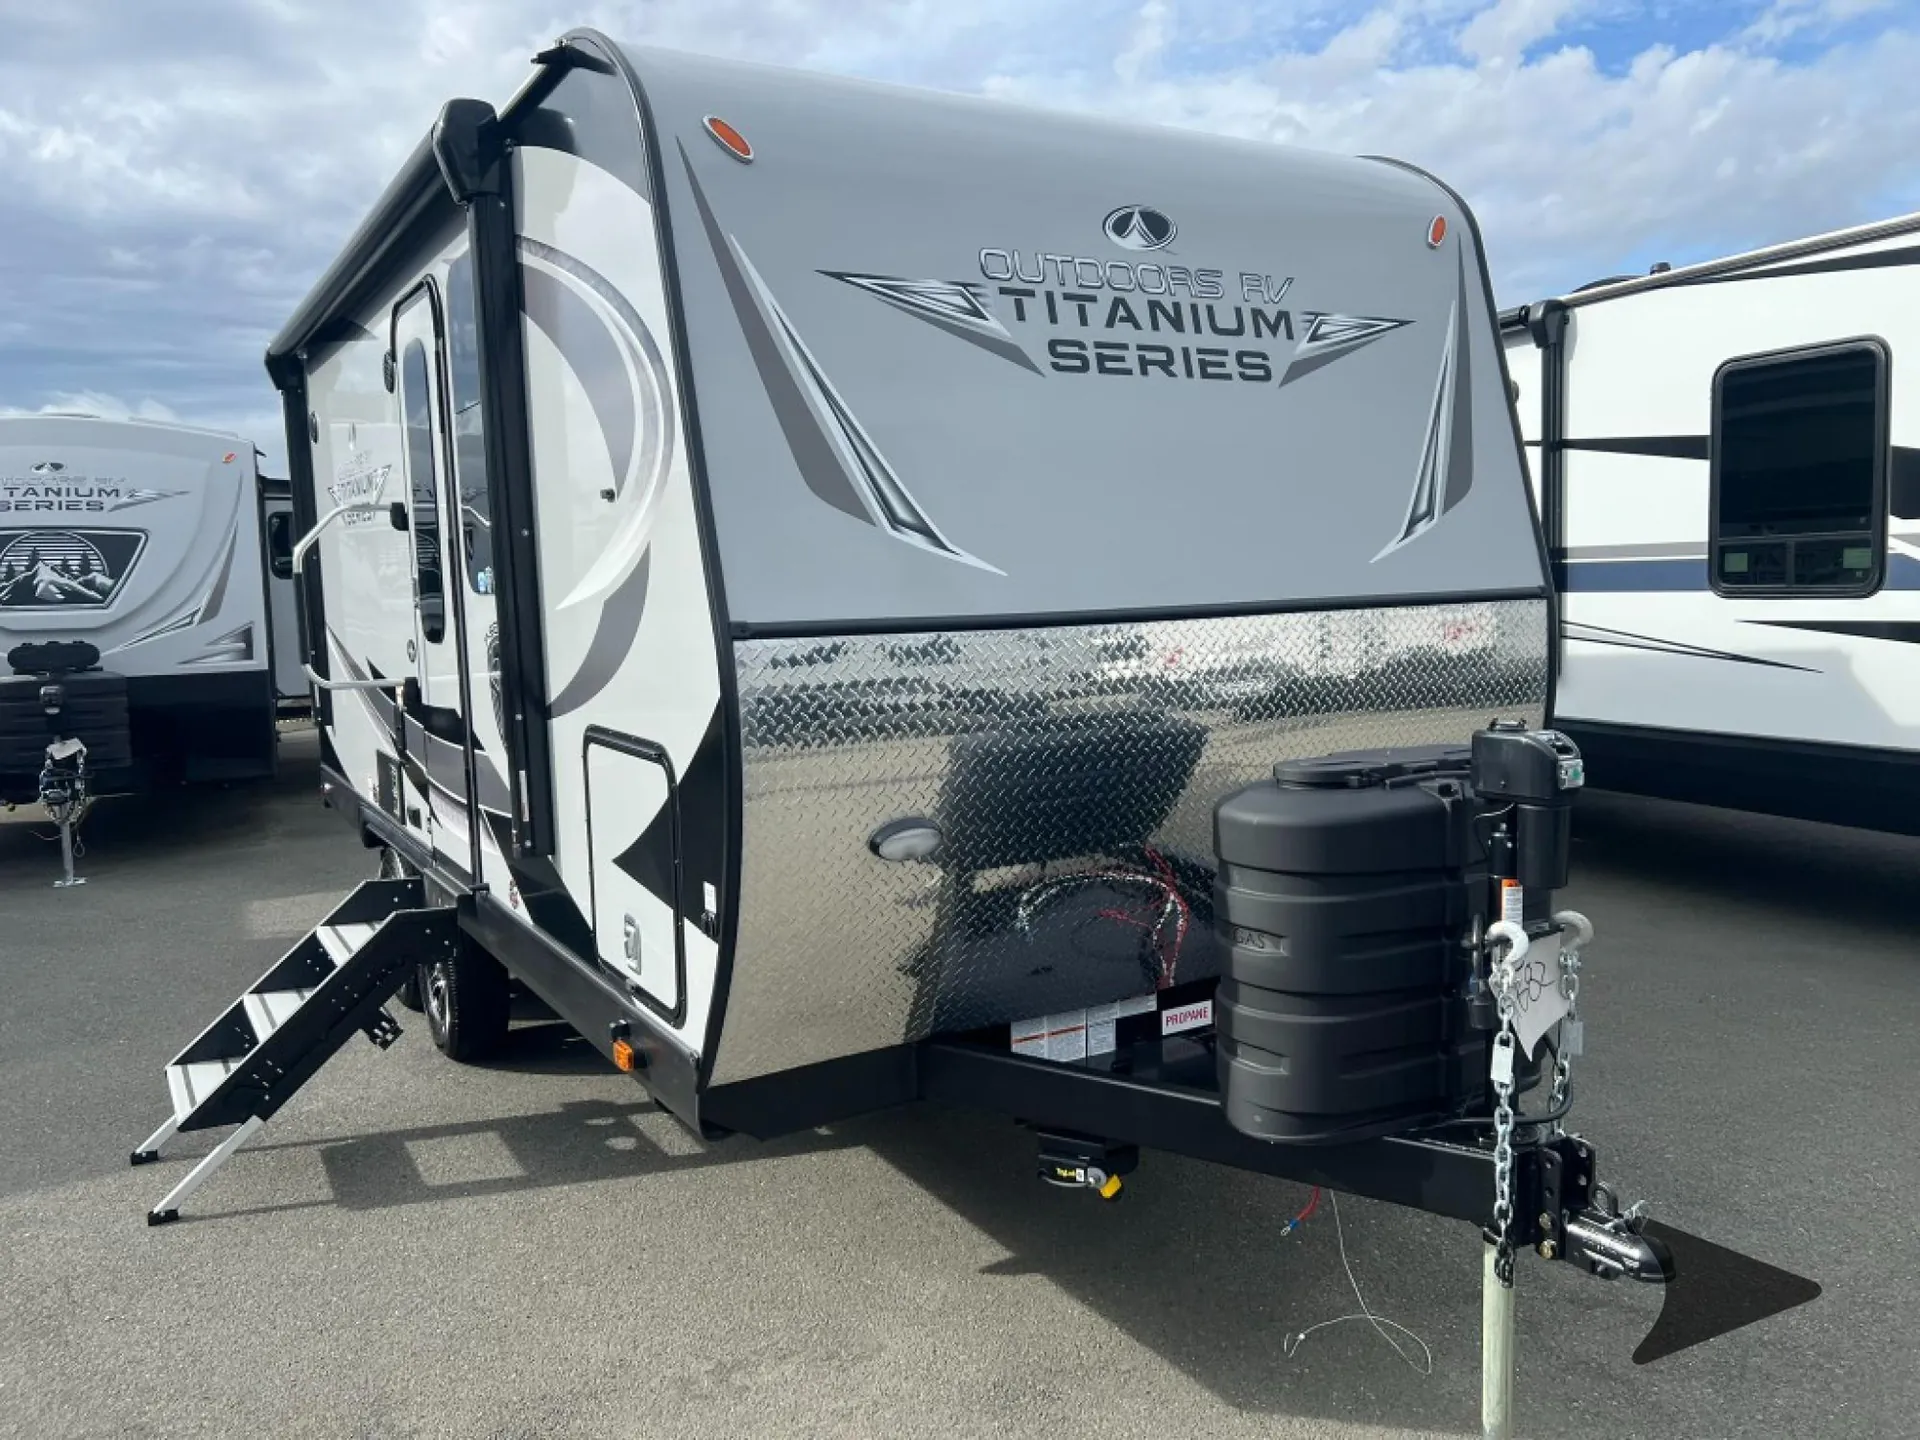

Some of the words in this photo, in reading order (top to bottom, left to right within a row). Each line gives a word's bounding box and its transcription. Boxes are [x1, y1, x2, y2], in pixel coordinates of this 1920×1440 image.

[978, 247, 1224, 300] OUTDOORS
[1239, 271, 1294, 304] RV
[998, 286, 1294, 340] TITANIUM
[1047, 338, 1272, 382] SERIES
[1165, 1006, 1209, 1027] PROPANE
